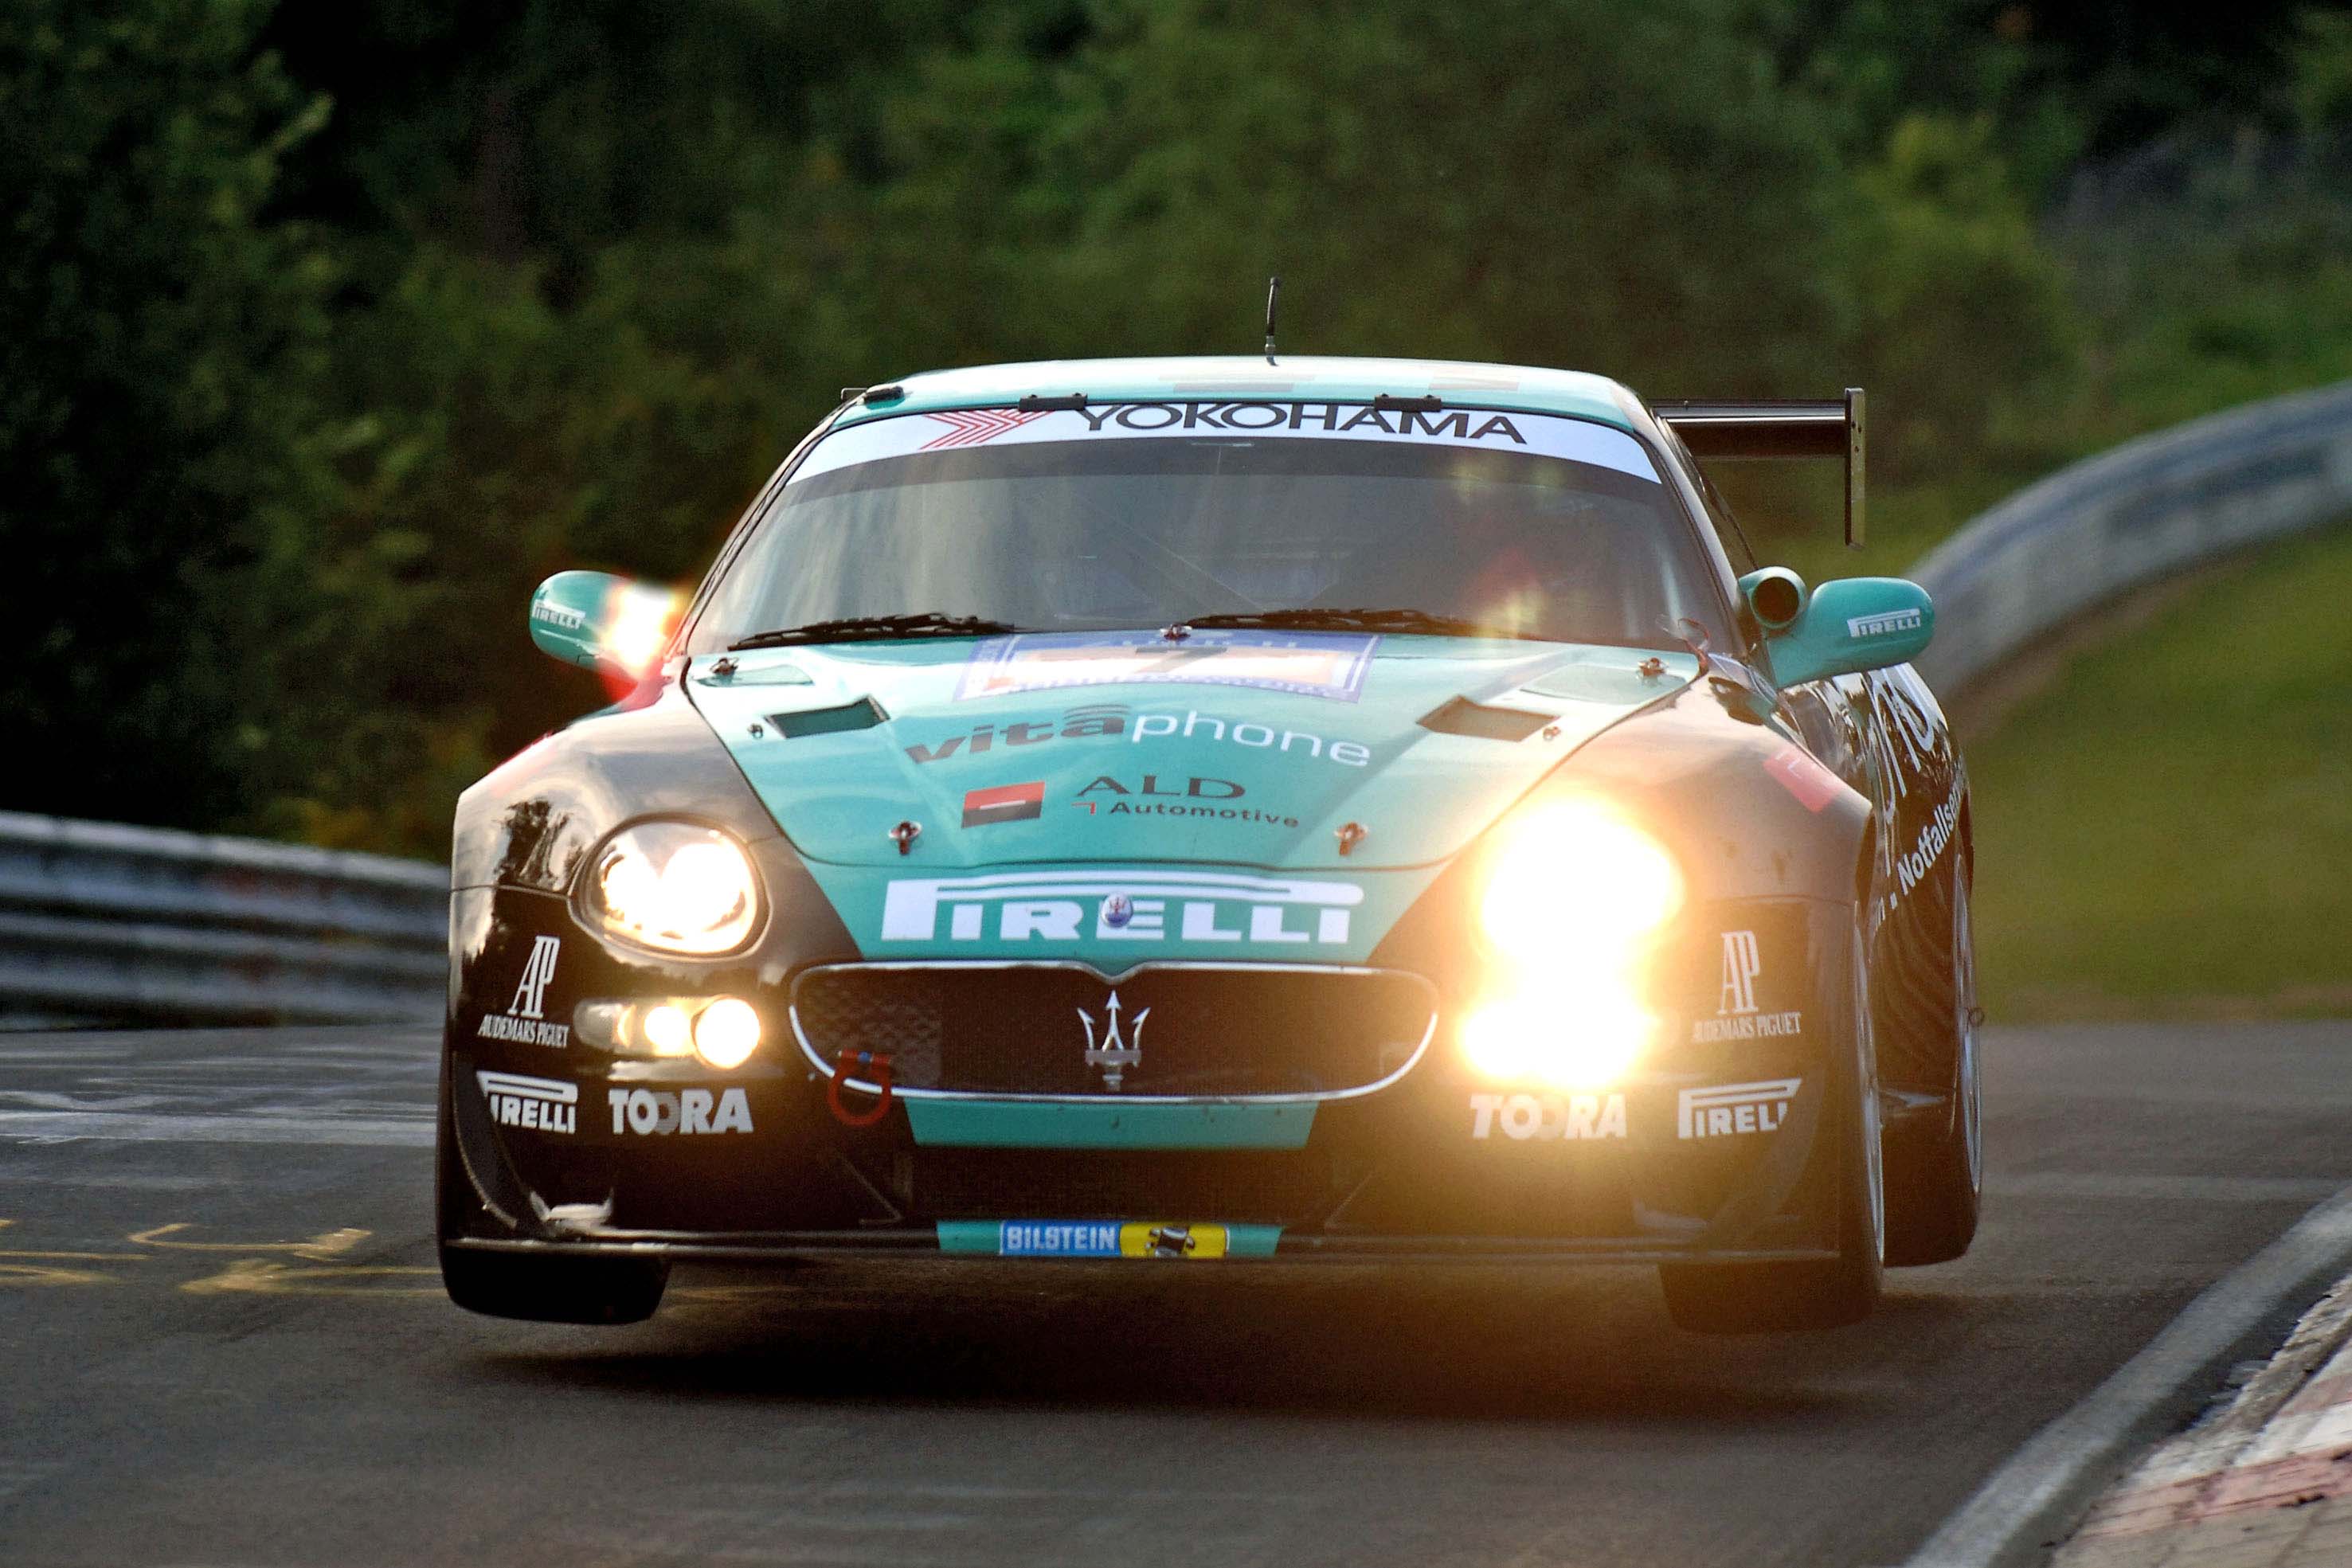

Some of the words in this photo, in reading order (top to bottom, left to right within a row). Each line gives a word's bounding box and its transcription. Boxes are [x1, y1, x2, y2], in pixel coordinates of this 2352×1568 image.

[1078, 403, 1527, 444] YOKOHAMA
[1847, 608, 1920, 637] PIRELLI
[903, 704, 1371, 767] vitaphone
[1077, 775, 1246, 799] ALD
[1110, 802, 1298, 827] Automotive
[881, 870, 1364, 942] PIRELLI
[478, 1014, 537, 1044] AUDEMARS
[536, 1022, 570, 1049] PIGUET
[1756, 1011, 1801, 1038] PIGUET
[1007, 1226, 1115, 1251] BILSTEIN
